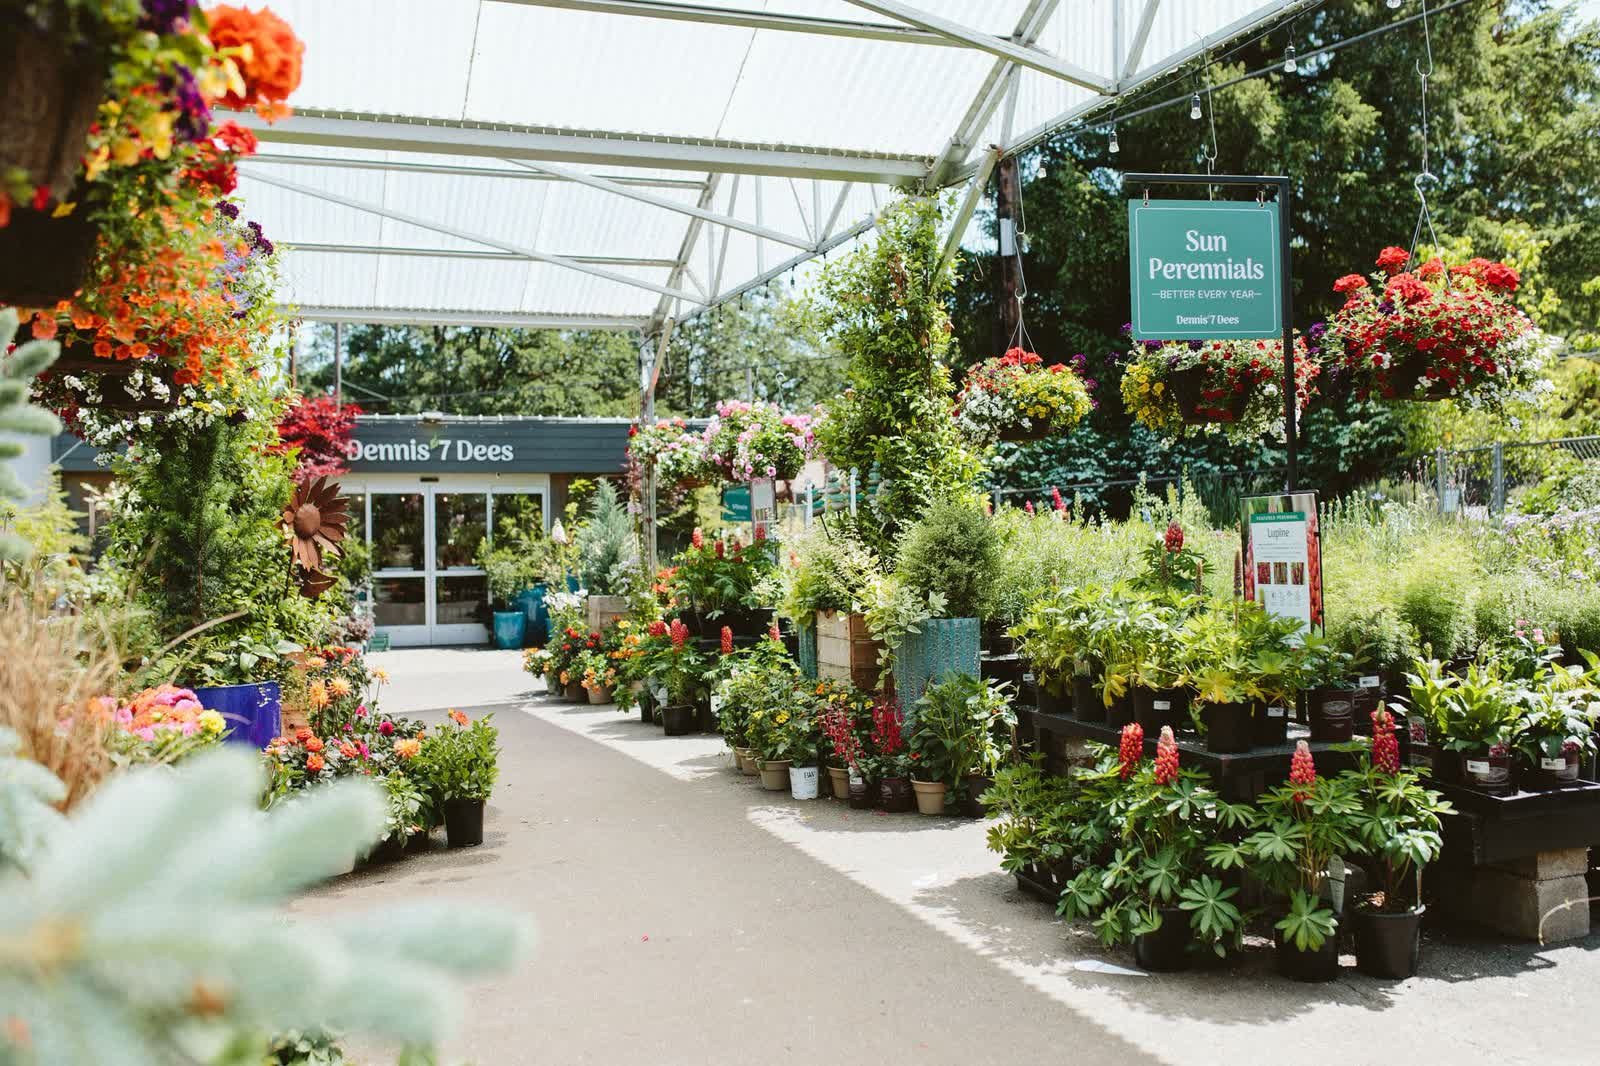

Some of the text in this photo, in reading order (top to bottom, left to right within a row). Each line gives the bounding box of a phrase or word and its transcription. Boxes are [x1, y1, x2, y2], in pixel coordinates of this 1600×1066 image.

[1185, 230, 1227, 252] Sun
[1149, 258, 1264, 280] Perennials
[1160, 289, 1254, 299] BETTER EVERY YEAR
[1217, 314, 1240, 325] Dees
[456, 439, 514, 461] Dees
[1267, 527, 1290, 540] Lupine
